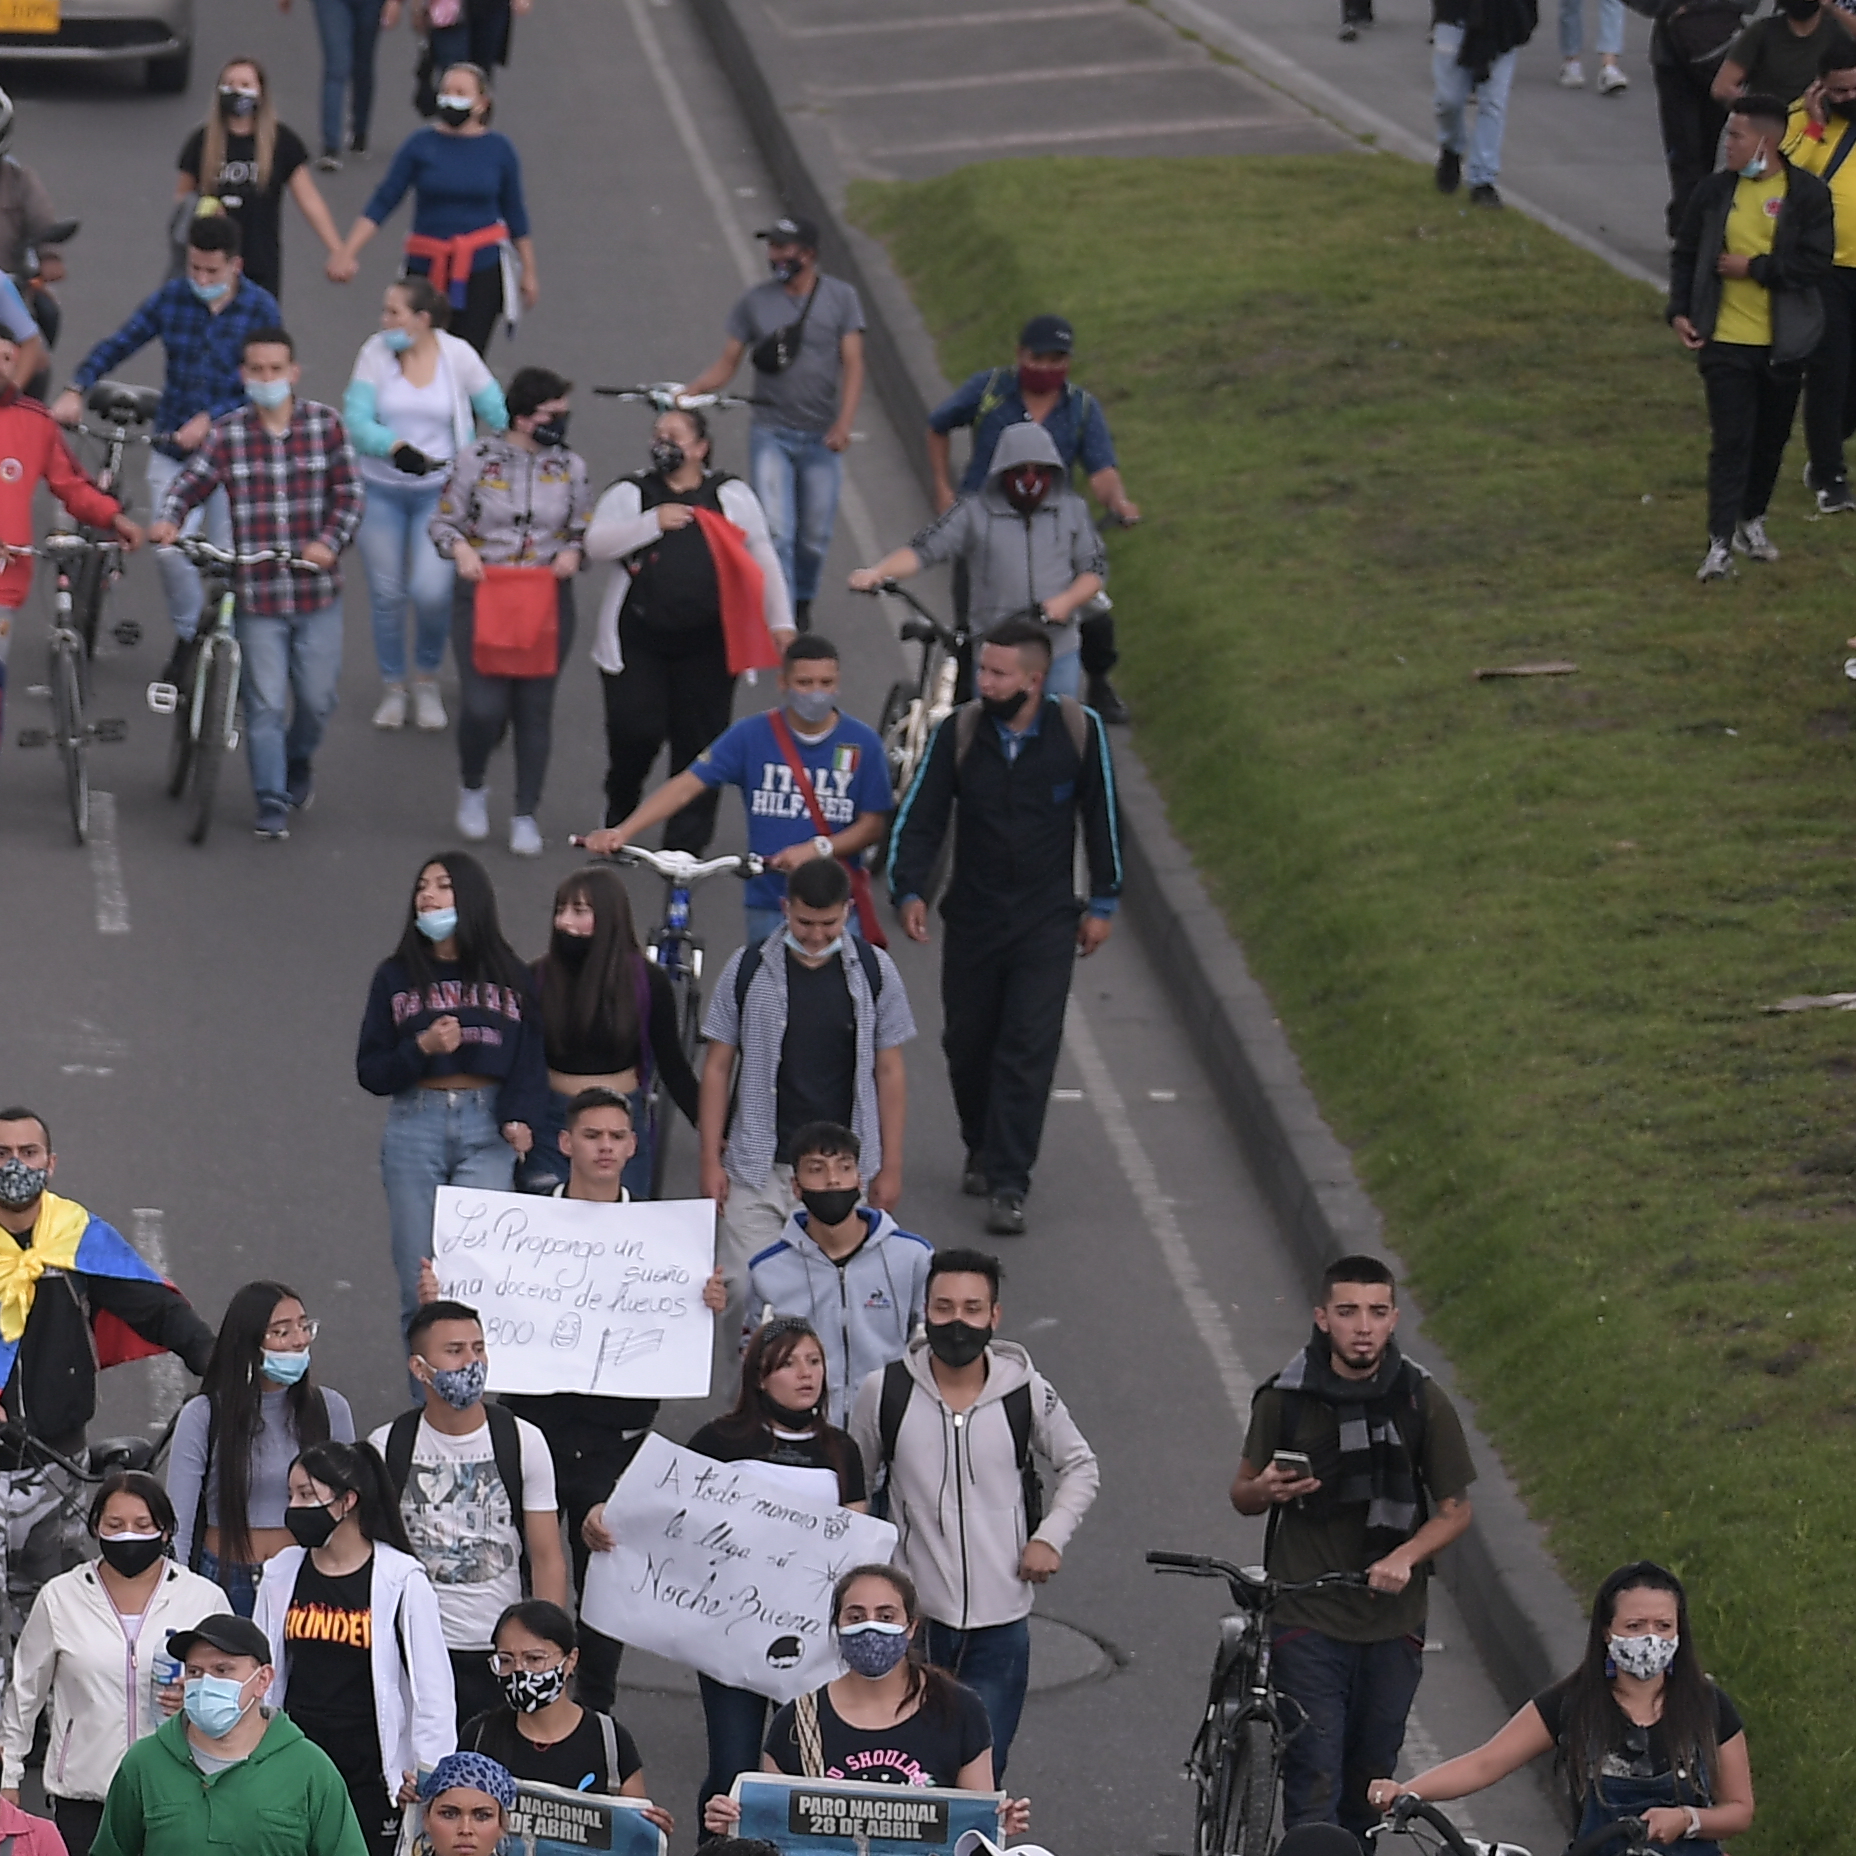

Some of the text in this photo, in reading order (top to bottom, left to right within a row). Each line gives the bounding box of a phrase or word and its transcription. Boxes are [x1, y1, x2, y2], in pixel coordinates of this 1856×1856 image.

[494, 1207, 607, 1289] Propongo
[614, 1239, 646, 1261] un
[495, 1265, 564, 1302] docena
[575, 1280, 605, 1311] de
[606, 1282, 689, 1317] huevos
[654, 1457, 682, 1497] A
[692, 1465, 749, 1506] todo
[693, 1521, 752, 1567] llega
[631, 1552, 824, 1637] Noche Buena
[520, 1795, 605, 1830] NACIONAL
[534, 1816, 588, 1844] ABRIL
[799, 1796, 939, 1823] PARO NACIONAL
[810, 1816, 922, 1840] 28 DE ABRIL
